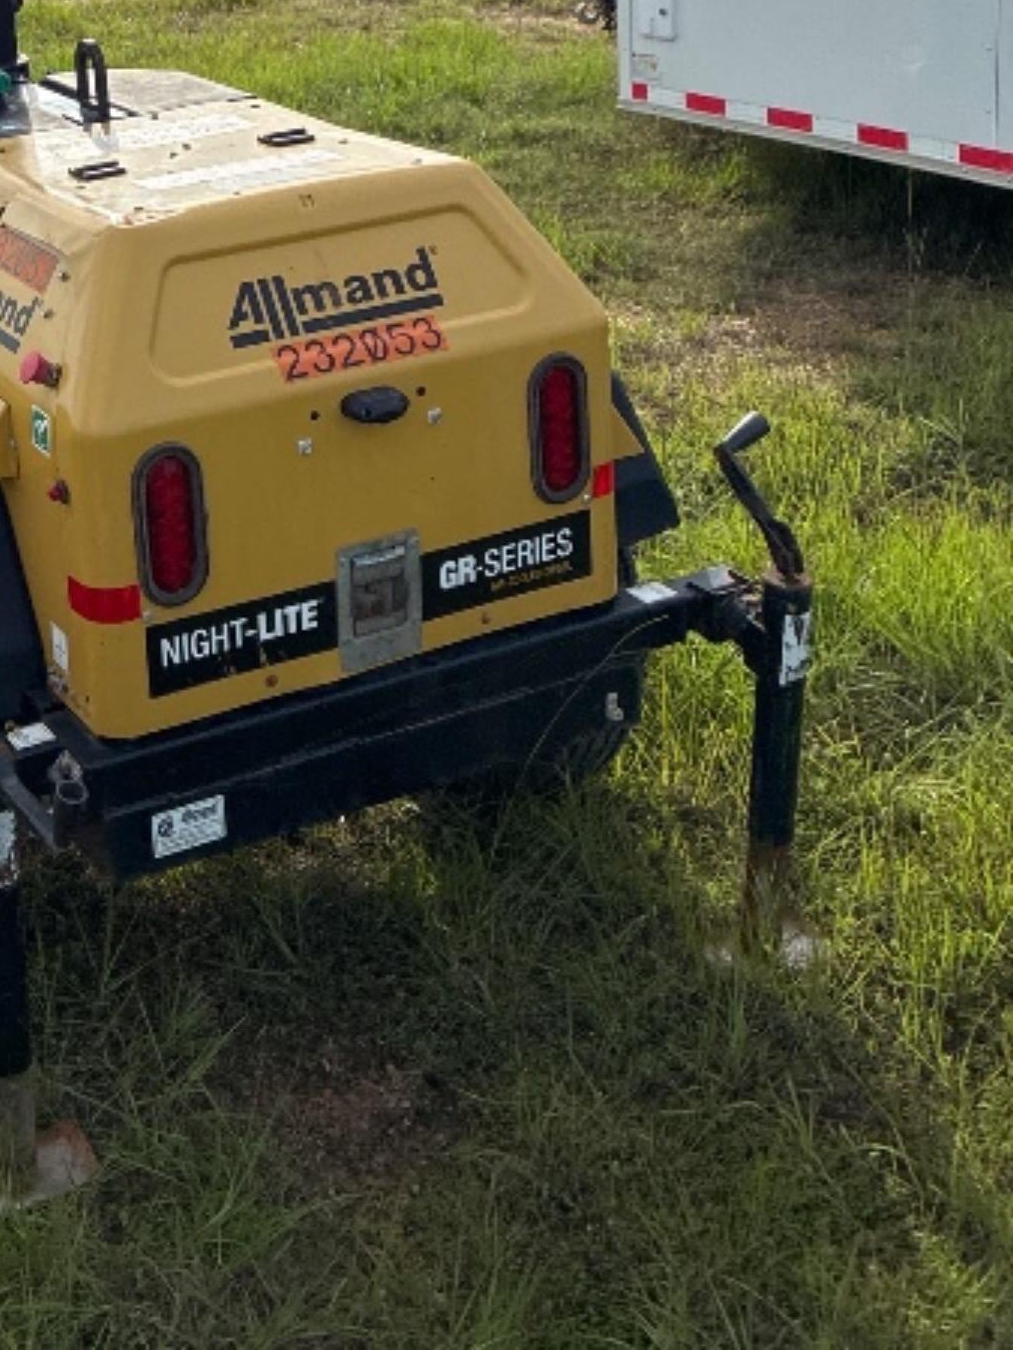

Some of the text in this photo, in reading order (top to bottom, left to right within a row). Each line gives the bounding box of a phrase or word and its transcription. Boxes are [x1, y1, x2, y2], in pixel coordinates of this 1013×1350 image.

[228, 245, 439, 340] Allmand
[276, 316, 443, 384] 232053
[439, 527, 574, 591] GR-SERIES
[159, 598, 320, 669] NIGHT-LITE
